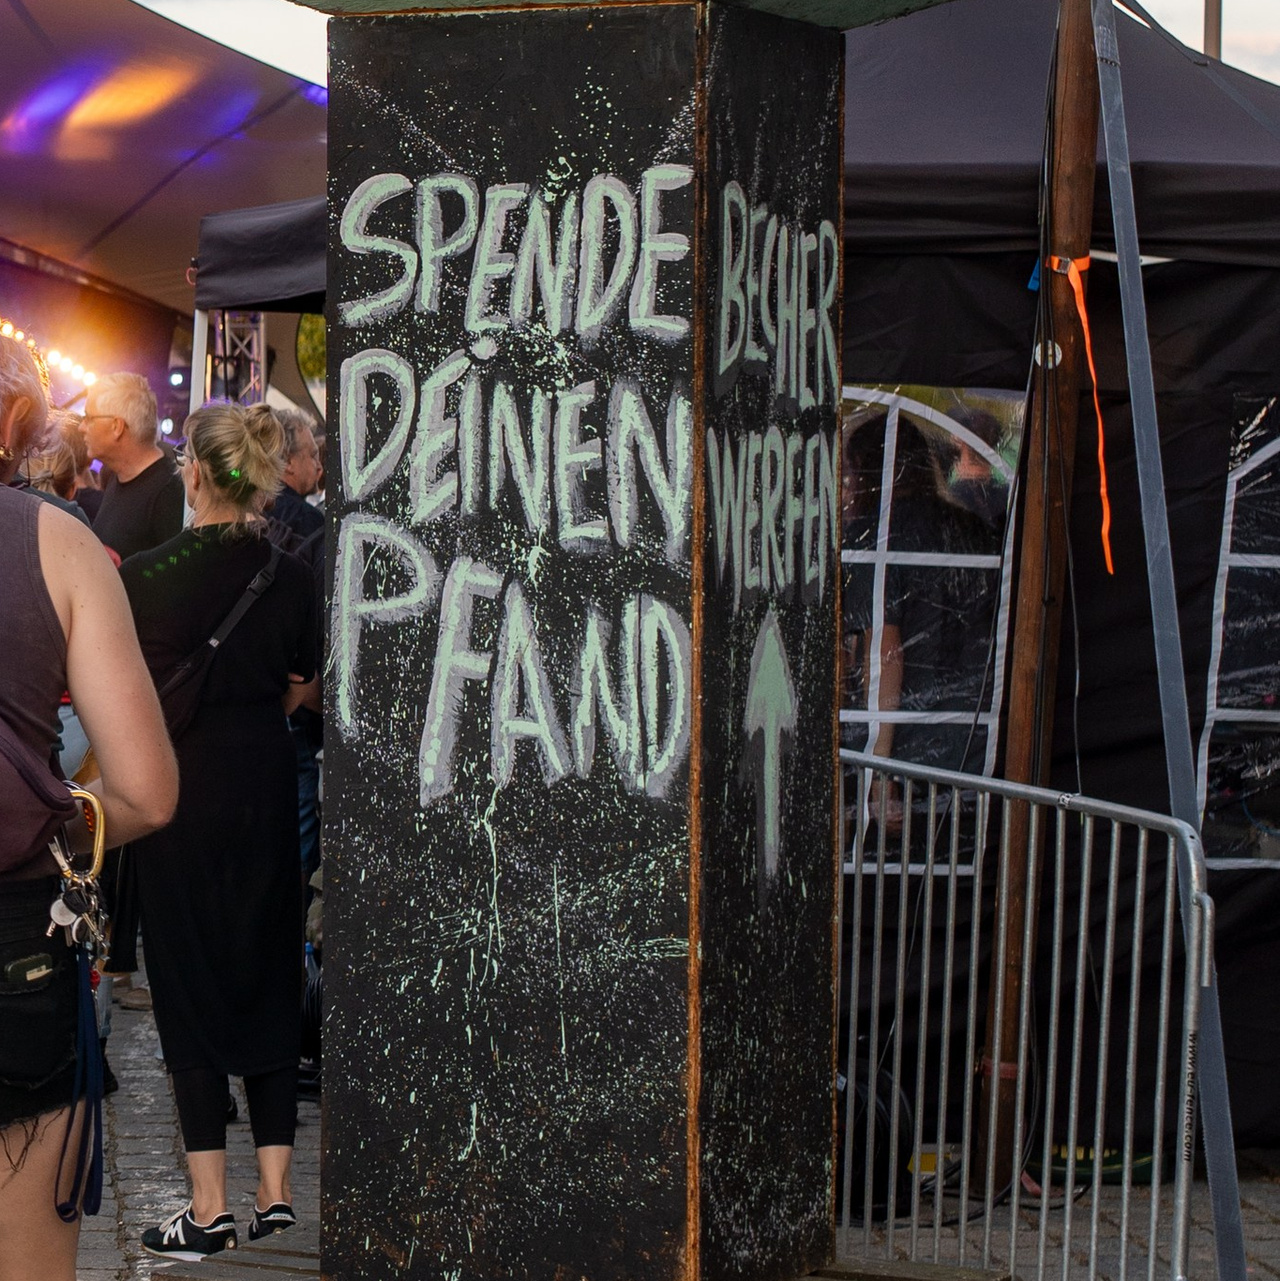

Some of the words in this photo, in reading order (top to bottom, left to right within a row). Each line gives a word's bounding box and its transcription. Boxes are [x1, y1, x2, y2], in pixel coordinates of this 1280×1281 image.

[336, 164, 696, 346] SPENDE
[719, 181, 837, 410] BECHER
[338, 336, 693, 558] DEINEN
[707, 426, 838, 614] WERFEN
[330, 513, 693, 805] PFAND
[1184, 1032, 1198, 1162] www.eu-fence.com
